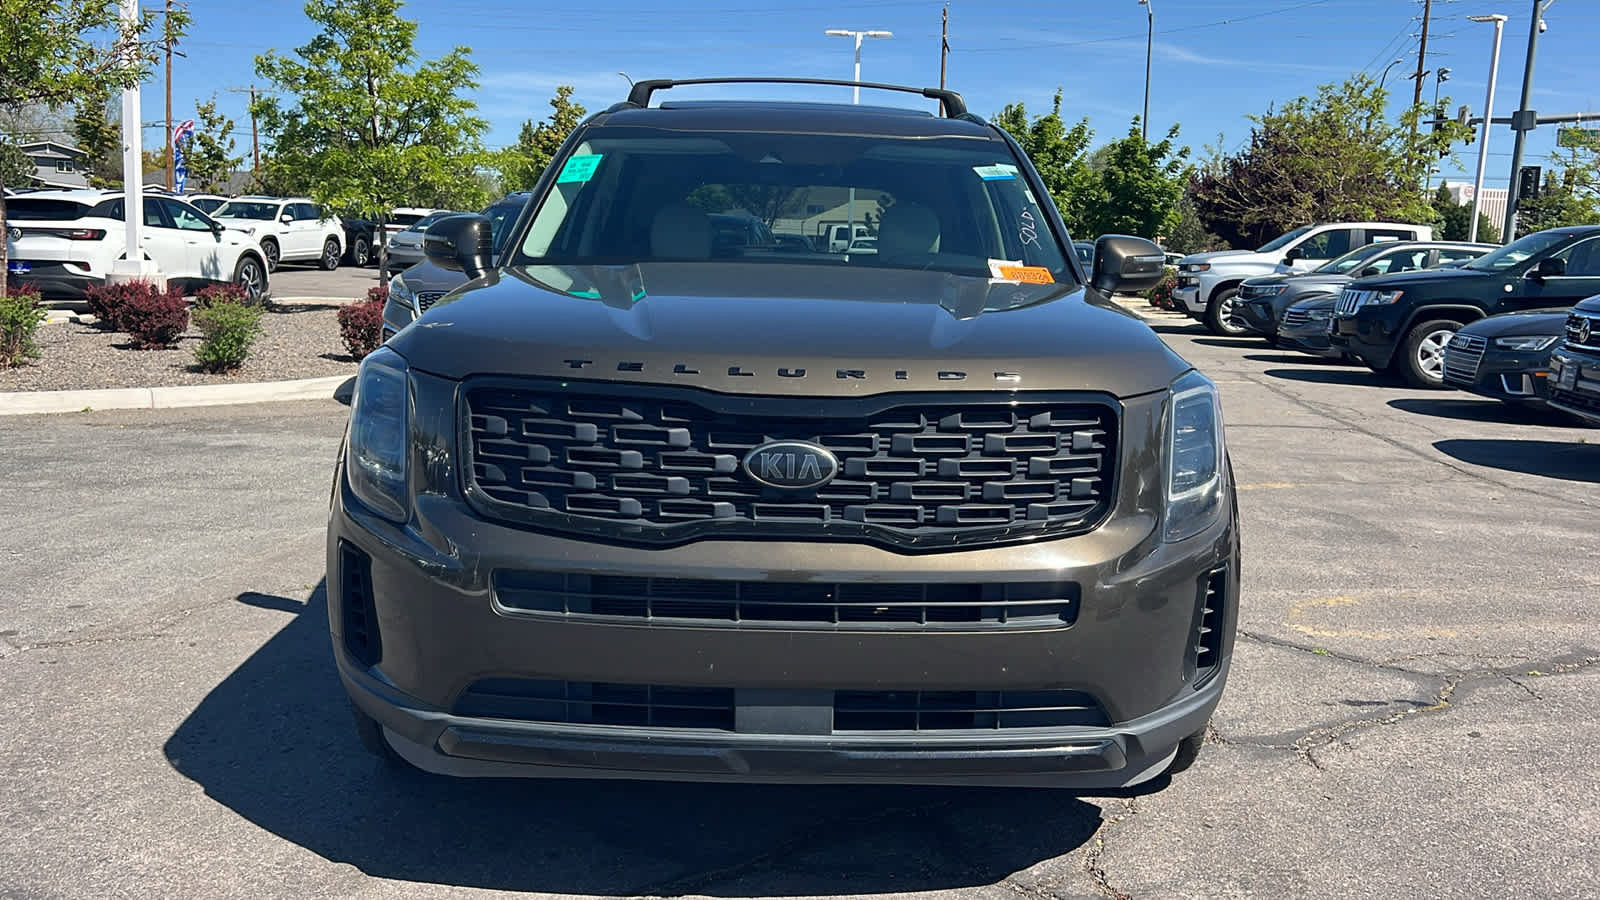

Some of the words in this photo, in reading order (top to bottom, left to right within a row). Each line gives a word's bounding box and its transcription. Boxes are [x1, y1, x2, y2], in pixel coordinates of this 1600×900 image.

[1019, 210, 1042, 250] SOLD
[563, 359, 1020, 382] TELLURIDE
[760, 452, 822, 480] KIA
